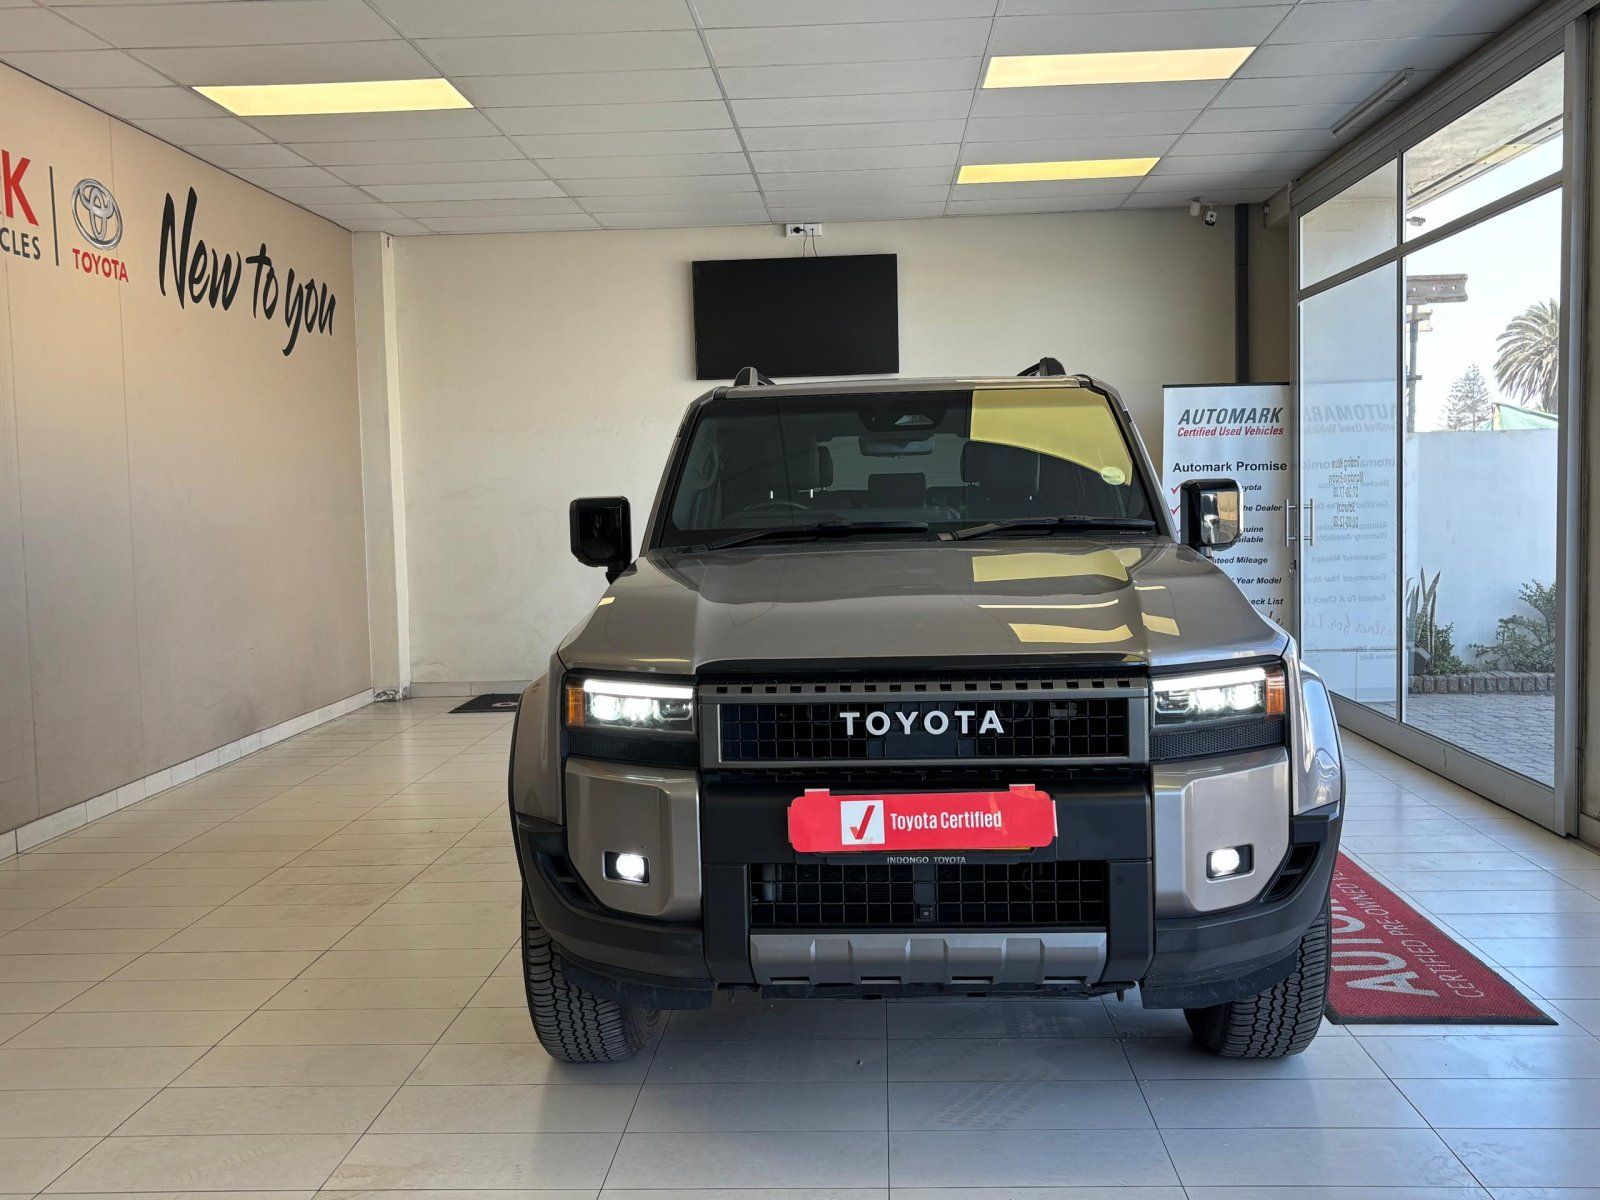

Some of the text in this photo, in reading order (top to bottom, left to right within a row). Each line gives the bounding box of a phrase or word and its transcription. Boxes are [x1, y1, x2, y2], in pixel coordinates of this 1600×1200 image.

[1, 149, 39, 227] K
[0, 226, 41, 261] CLES
[72, 248, 129, 283] TOYOTA
[159, 186, 336, 356] New to you
[1178, 407, 1284, 425] AUTOMARK
[1177, 425, 1285, 437] Certified Used Vehicles
[1172, 460, 1288, 473] Automark Promise
[1242, 484, 1262, 492] yota
[1255, 504, 1283, 512] Dealer
[1236, 556, 1268, 566] Mileage
[1236, 577, 1282, 585] Year Model
[1249, 598, 1265, 606] eck
[839, 709, 1004, 736] TOYOTA
[890, 810, 1002, 832] Toyota Certified
[887, 856, 967, 865] INDONGO TOYOTA
[1331, 898, 1440, 998] AUTO
[1401, 939, 1484, 998] CERTIFIED
